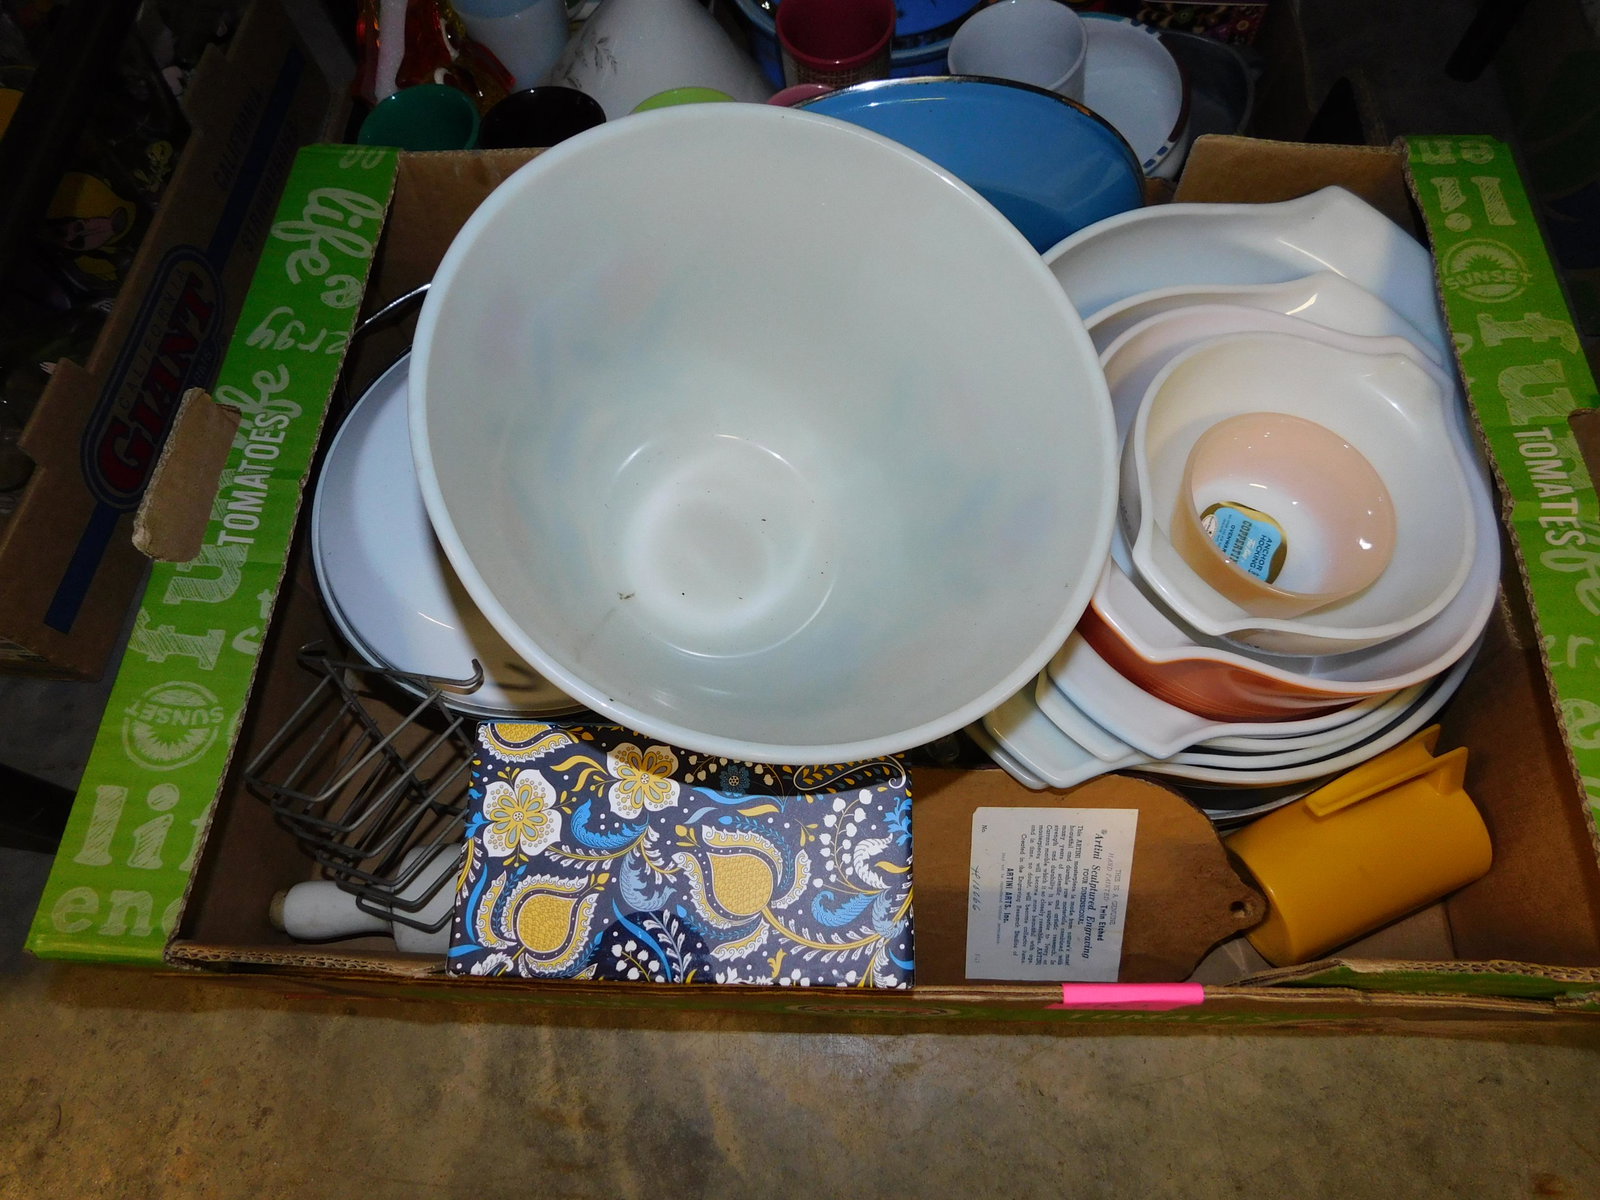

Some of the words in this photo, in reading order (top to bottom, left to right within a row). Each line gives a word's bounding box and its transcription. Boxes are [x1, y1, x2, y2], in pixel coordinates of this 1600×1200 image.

[270, 187, 385, 285] life
[1444, 269, 1534, 291] SUNSET
[99, 272, 214, 491] GIANT
[217, 413, 290, 545] TOMATOES
[1512, 426, 1587, 547] TOMATES
[1249, 534, 1266, 569] HOCKING
[1256, 537, 1272, 571] ANCHOR
[123, 704, 226, 730] SUNSET
[1091, 833, 1104, 859] Artini
[1005, 868, 1013, 888] ARTINI
[1085, 864, 1101, 910] Sculptured
[1099, 905, 1107, 919] Twin
[1080, 916, 1095, 958] Engraving
[1096, 921, 1106, 941] Etched
